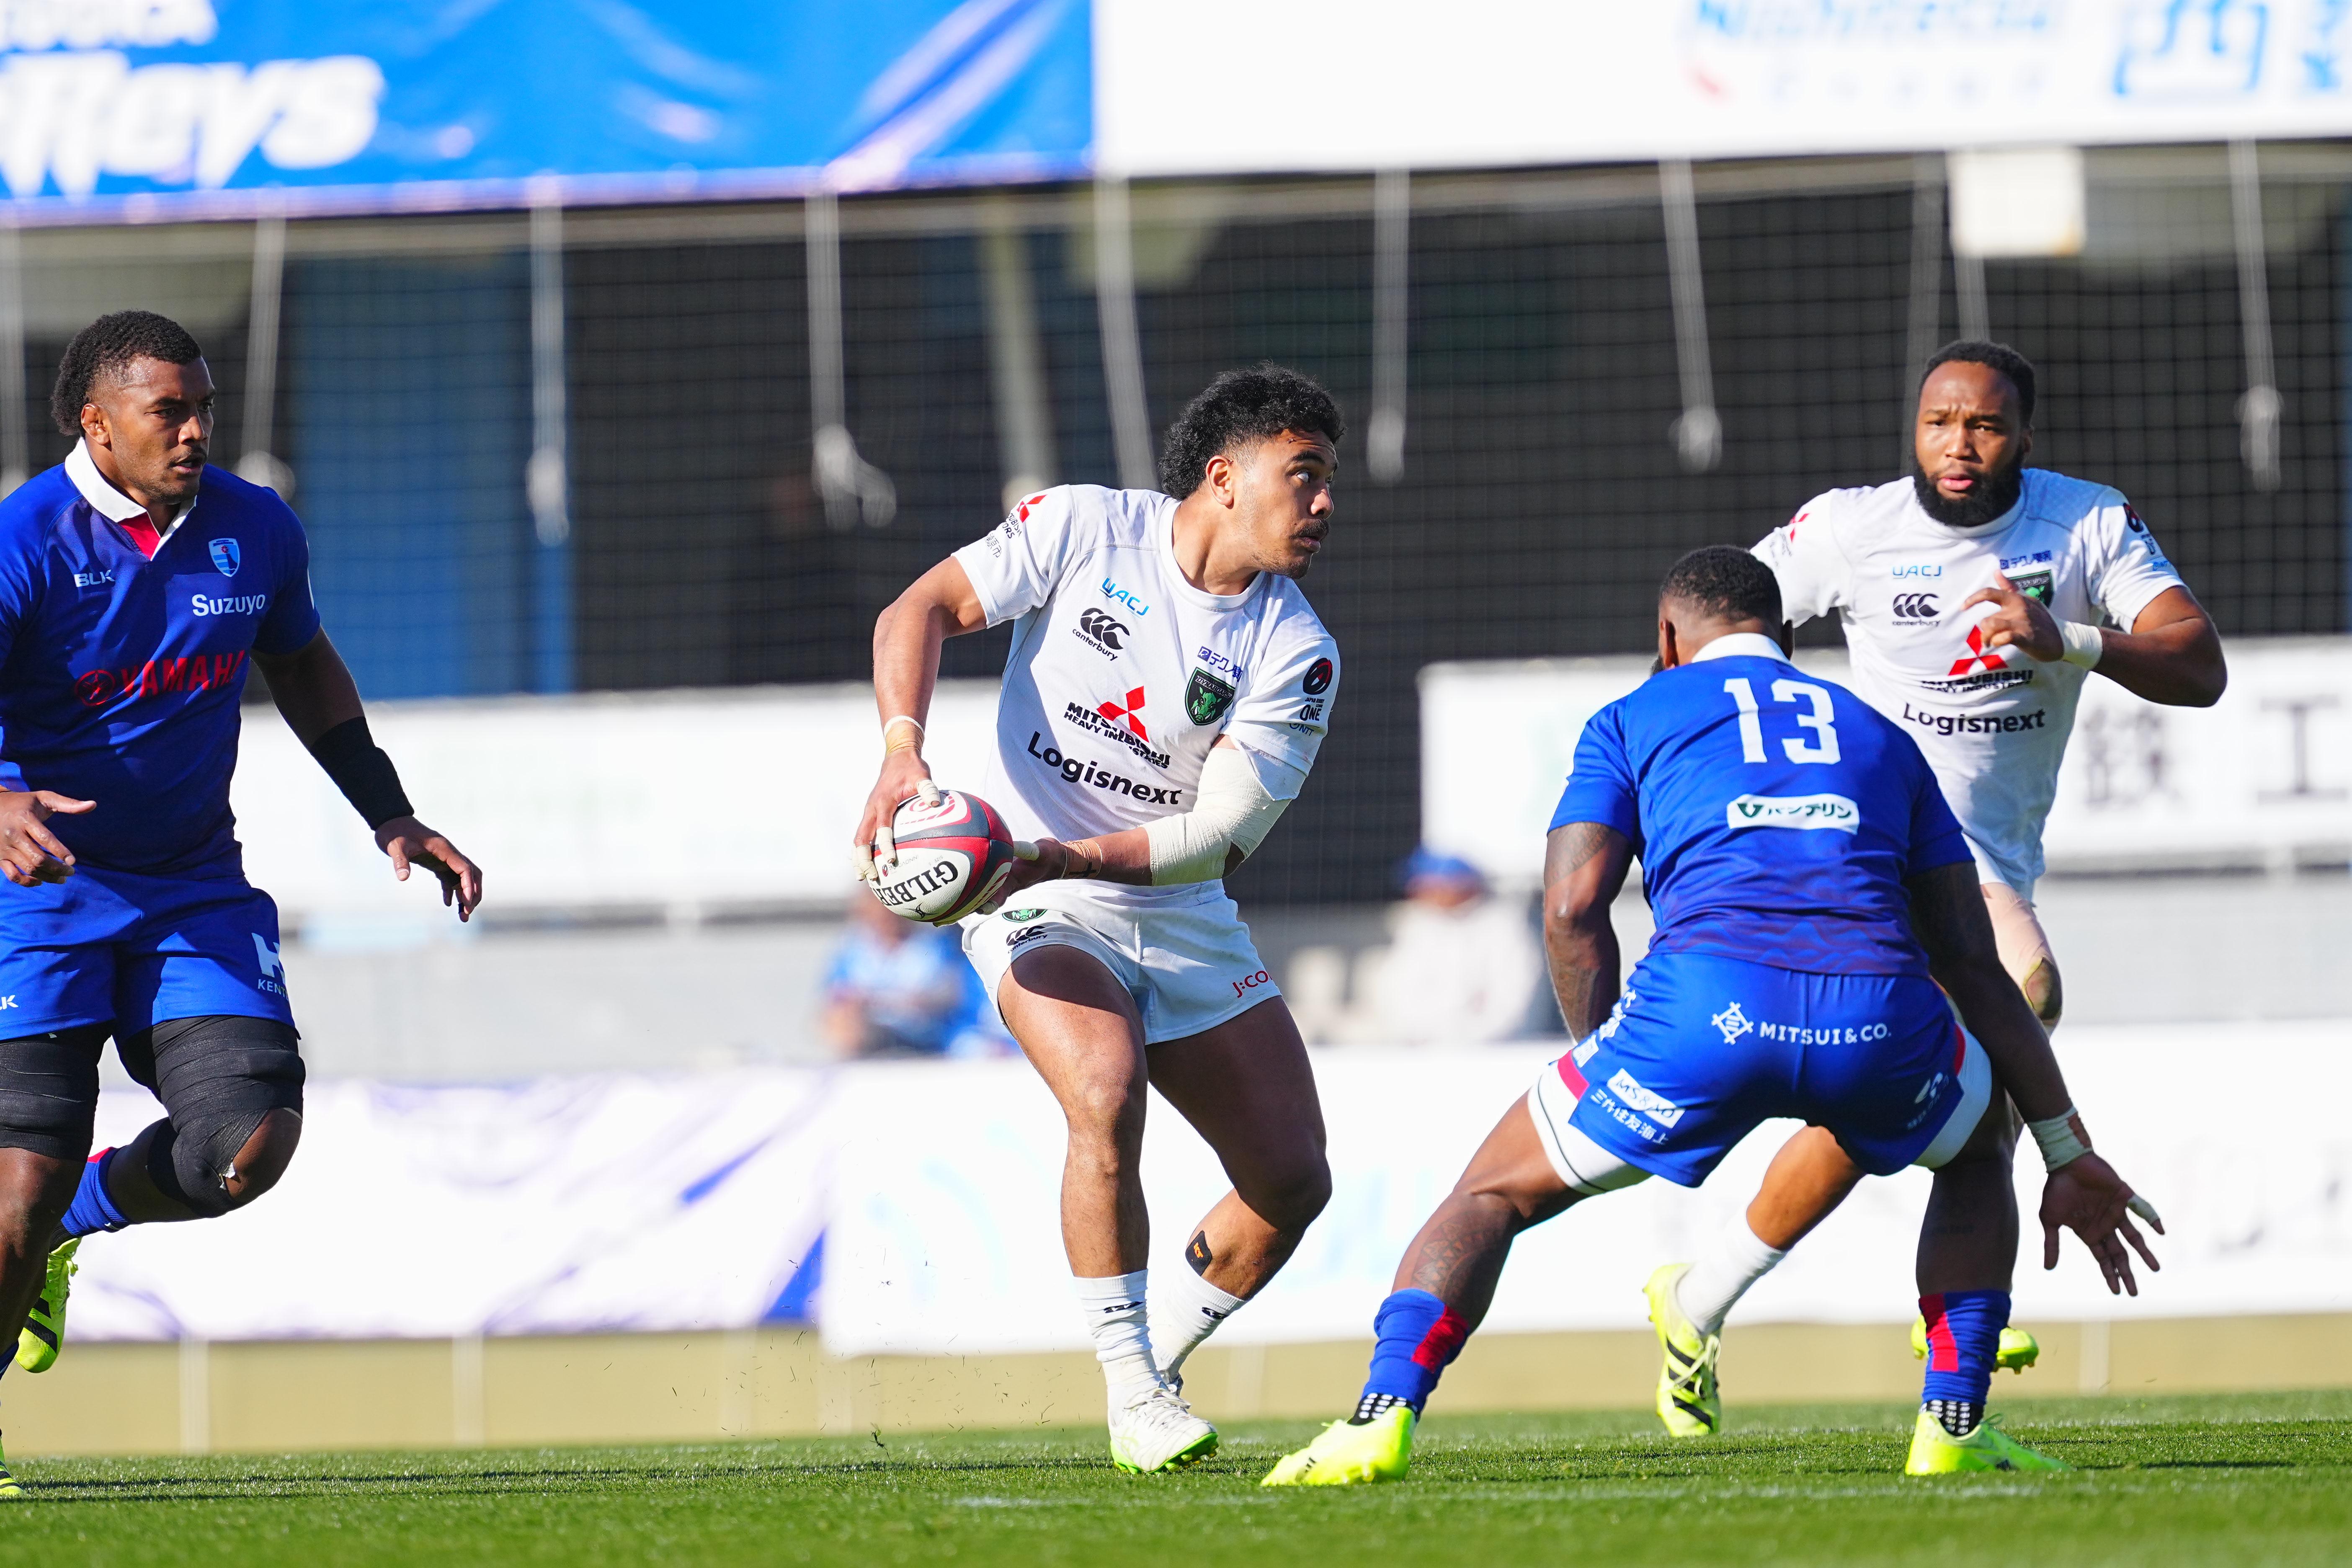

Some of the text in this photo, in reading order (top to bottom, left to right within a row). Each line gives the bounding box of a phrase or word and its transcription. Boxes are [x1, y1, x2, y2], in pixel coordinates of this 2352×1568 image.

[1003, 523, 1015, 539] ORS
[74, 569, 116, 588] BLK
[1893, 565, 1942, 580] UACJ
[192, 593, 266, 616] Suzuyo
[1099, 577, 1149, 618] UACJ
[1892, 619, 1941, 627] canterbury
[1072, 627, 1119, 661] canterbury
[1063, 712, 1102, 734] HEAVY
[1299, 704, 1322, 721] ONE
[1723, 678, 1841, 765] 13
[1903, 703, 2047, 736] Logisnext
[1298, 724, 1315, 736] NTT
[1027, 731, 1184, 805] Logisnext
[872, 861, 959, 906] GILBER
[1008, 934, 1048, 954] canterbury
[1232, 970, 1273, 998] J:CO
[1590, 1088, 1669, 1145] 三井住友海上
